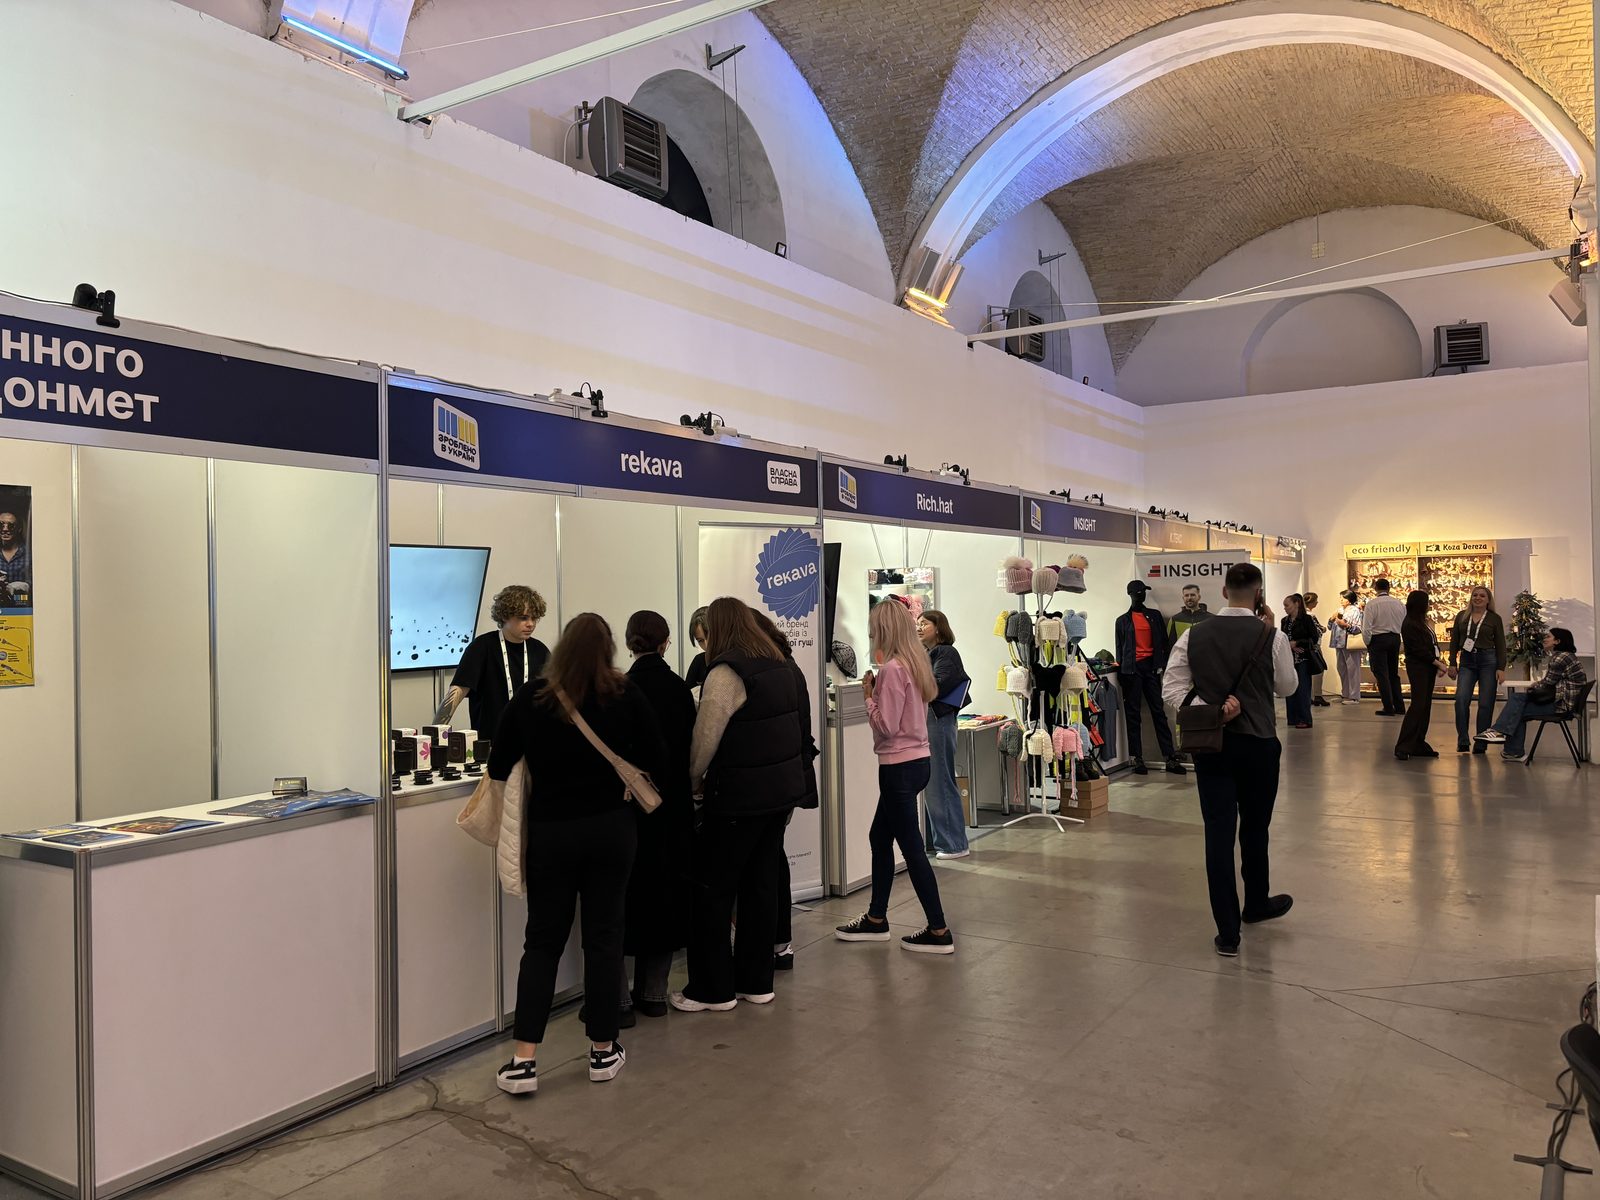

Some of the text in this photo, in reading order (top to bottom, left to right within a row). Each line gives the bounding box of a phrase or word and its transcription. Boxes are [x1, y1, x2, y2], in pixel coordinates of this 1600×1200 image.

[0, 376, 160, 422] онмет
[438, 434, 477, 456] ЗРОБЛЕНО
[441, 443, 475, 463] В УКРАЇНІ
[620, 450, 683, 478] rekava
[770, 467, 798, 478] ВЛАСНА
[770, 476, 798, 487] СПРАВА
[916, 493, 953, 515] Rich.hat
[1073, 517, 1097, 532] INSIGHT
[1351, 543, 1411, 555] eco friendly
[1442, 542, 1488, 551] Koza Dereza
[767, 562, 817, 589] rekava
[1163, 562, 1235, 578] INSIGHT
[786, 619, 809, 630] бренд
[784, 628, 808, 638] обів із
[798, 637, 814, 649] гущі
